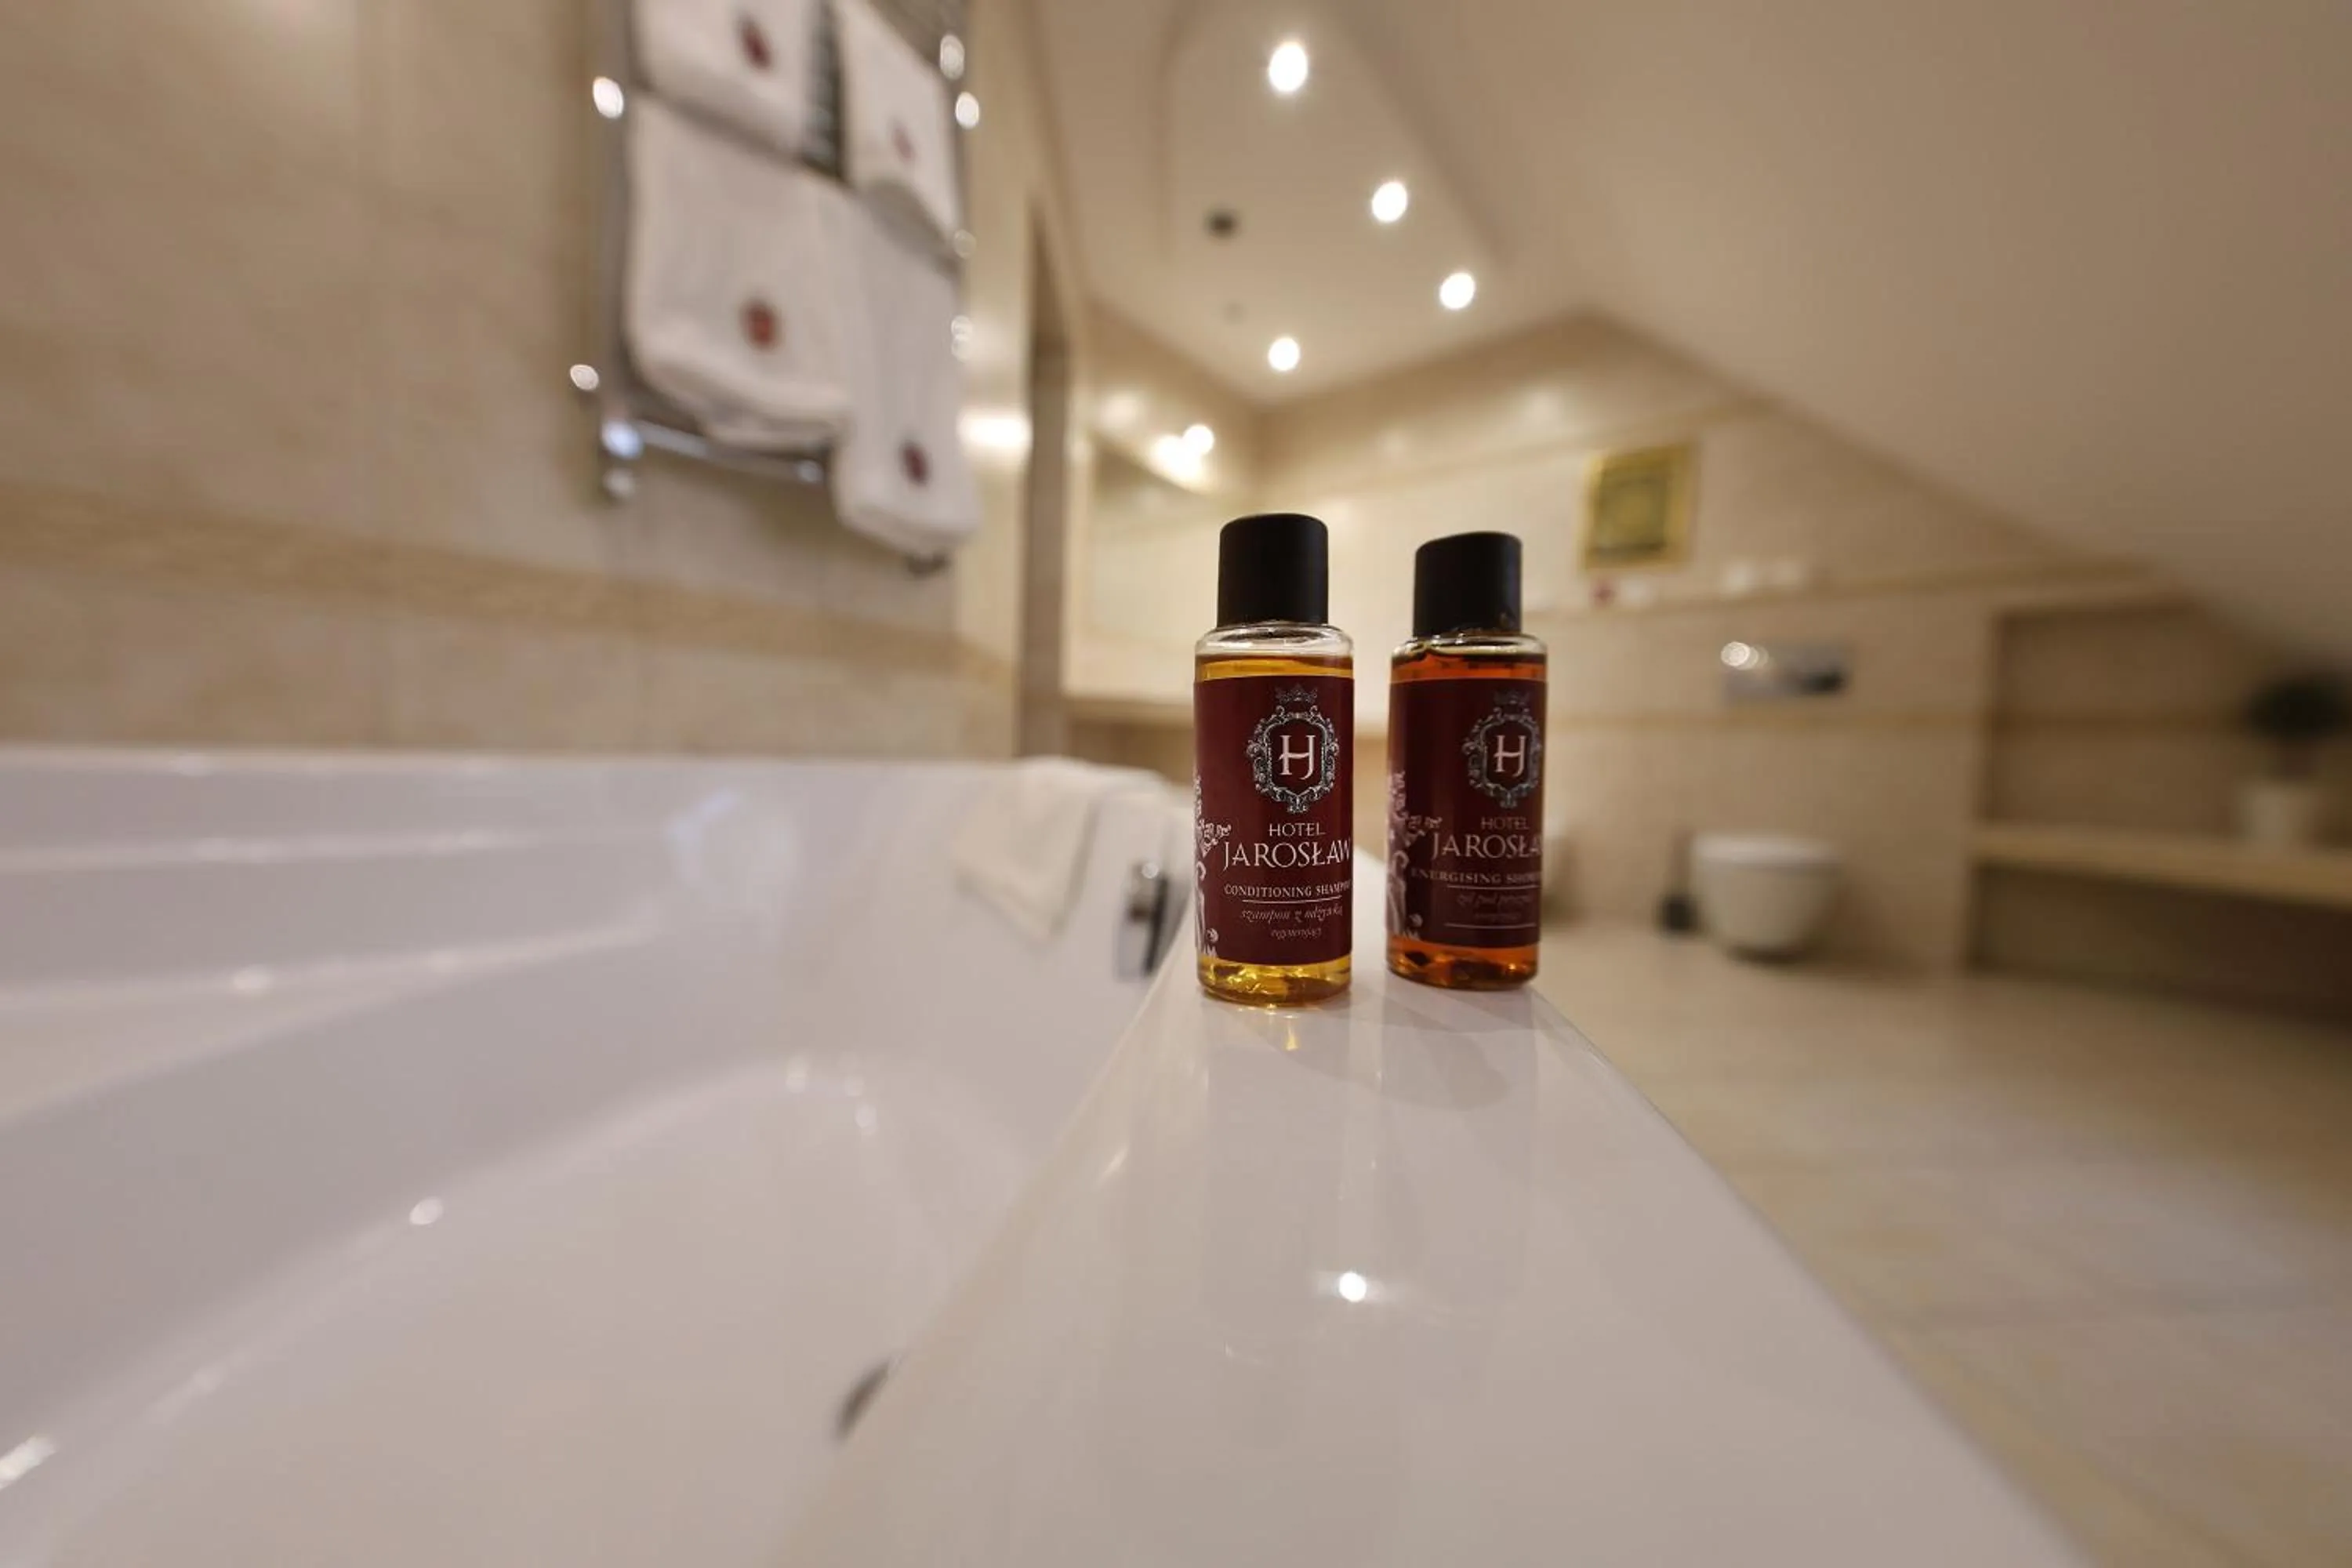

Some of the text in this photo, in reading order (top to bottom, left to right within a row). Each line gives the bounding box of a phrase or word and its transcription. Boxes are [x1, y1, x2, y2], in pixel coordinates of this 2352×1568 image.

[1277, 735, 1316, 780] HJ
[1494, 735, 1526, 777] HJ
[1269, 822, 1326, 837] HOTEL
[1482, 817, 1530, 830] HOTEL
[1223, 838, 1351, 871] JAROSŁAW
[1431, 833, 1542, 859] JAROSŁA
[1411, 868, 1501, 884] ENERGISING
[1224, 880, 1352, 898] CONDITIONING SHAMP
